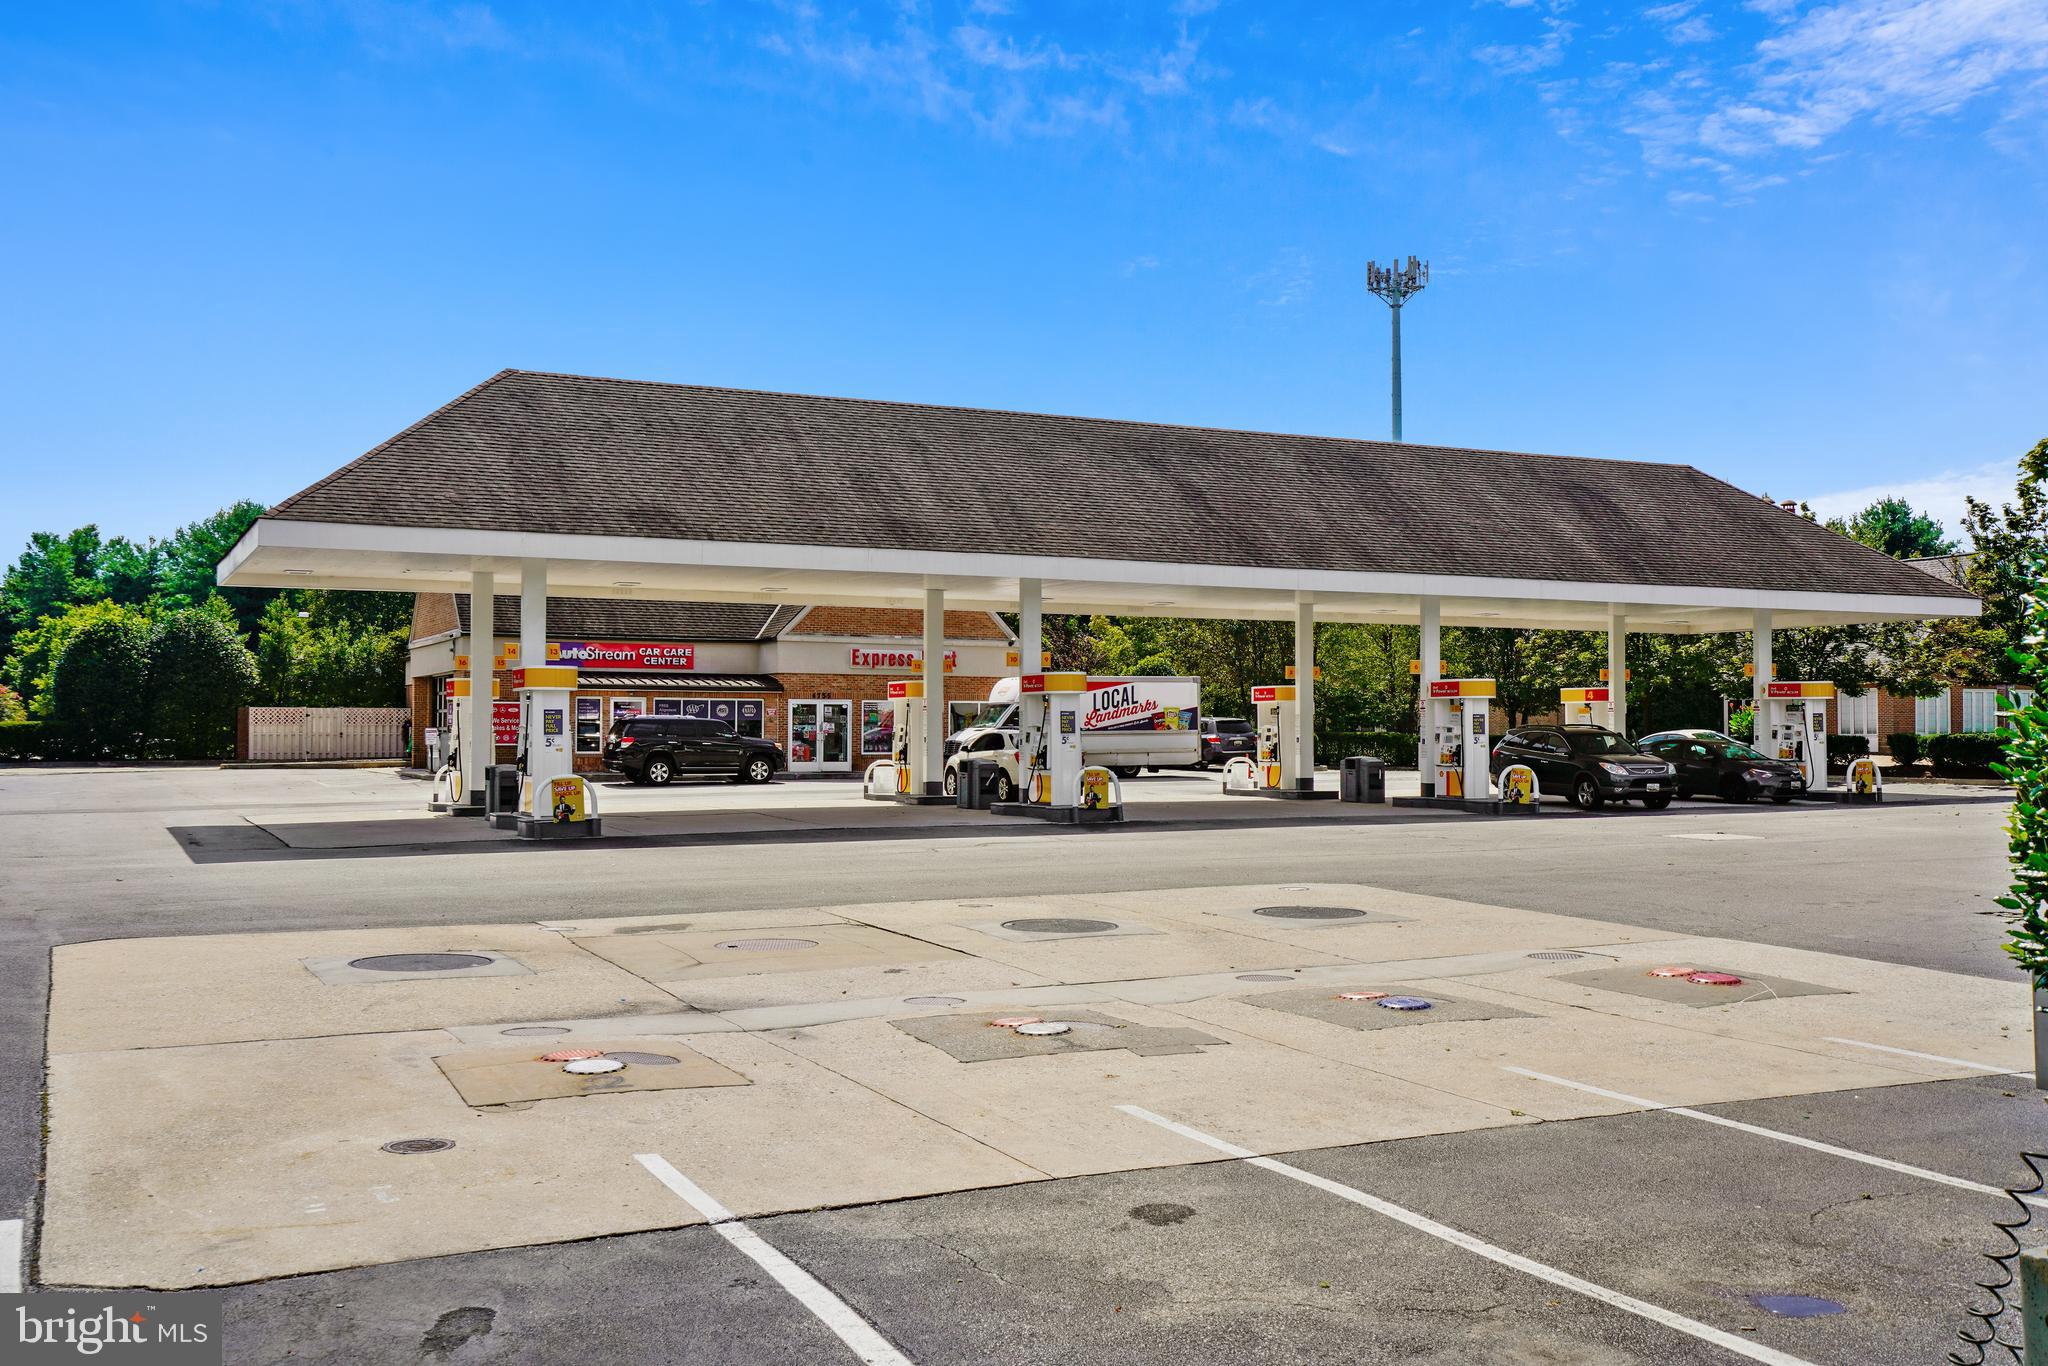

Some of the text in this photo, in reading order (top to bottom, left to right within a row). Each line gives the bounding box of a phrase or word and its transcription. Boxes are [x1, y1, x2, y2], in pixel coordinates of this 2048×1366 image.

[560, 646, 636, 660] utoStream
[639, 648, 692, 656] CAR CARE
[852, 648, 914, 668] Express
[644, 657, 687, 666] CENTER
[1093, 686, 1138, 712] LOCAL
[1587, 691, 1594, 700] 4
[1084, 700, 1158, 728] Landmarks
